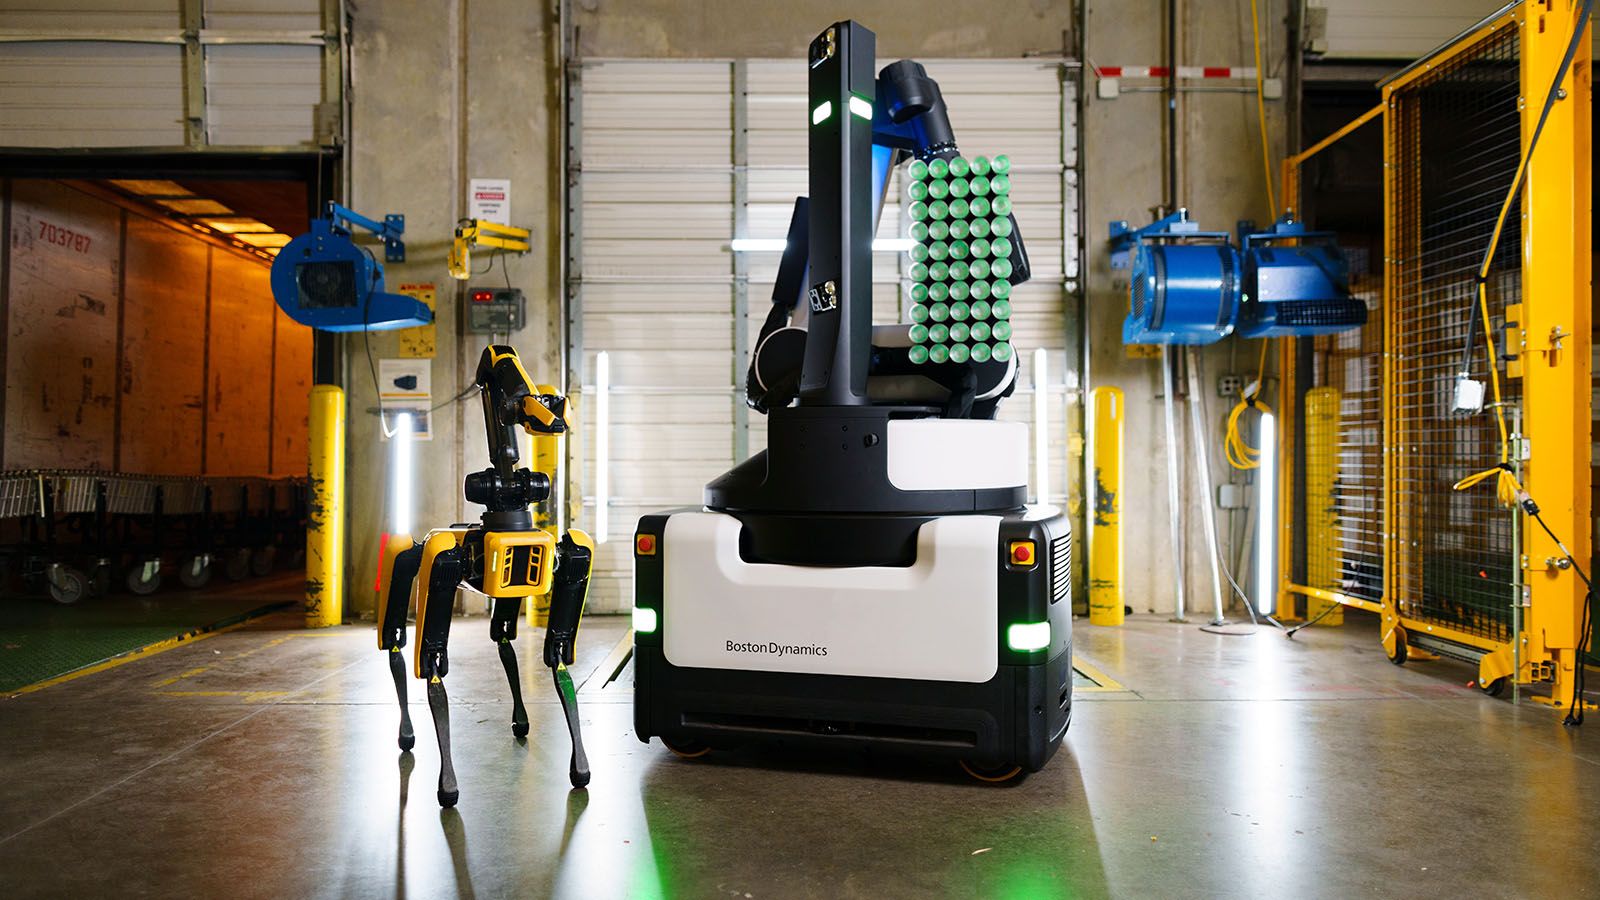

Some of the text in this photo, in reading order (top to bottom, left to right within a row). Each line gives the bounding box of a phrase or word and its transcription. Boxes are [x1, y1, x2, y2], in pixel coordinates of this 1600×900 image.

[39, 221, 91, 254] 703787
[726, 640, 827, 657] Boston Dynamics
